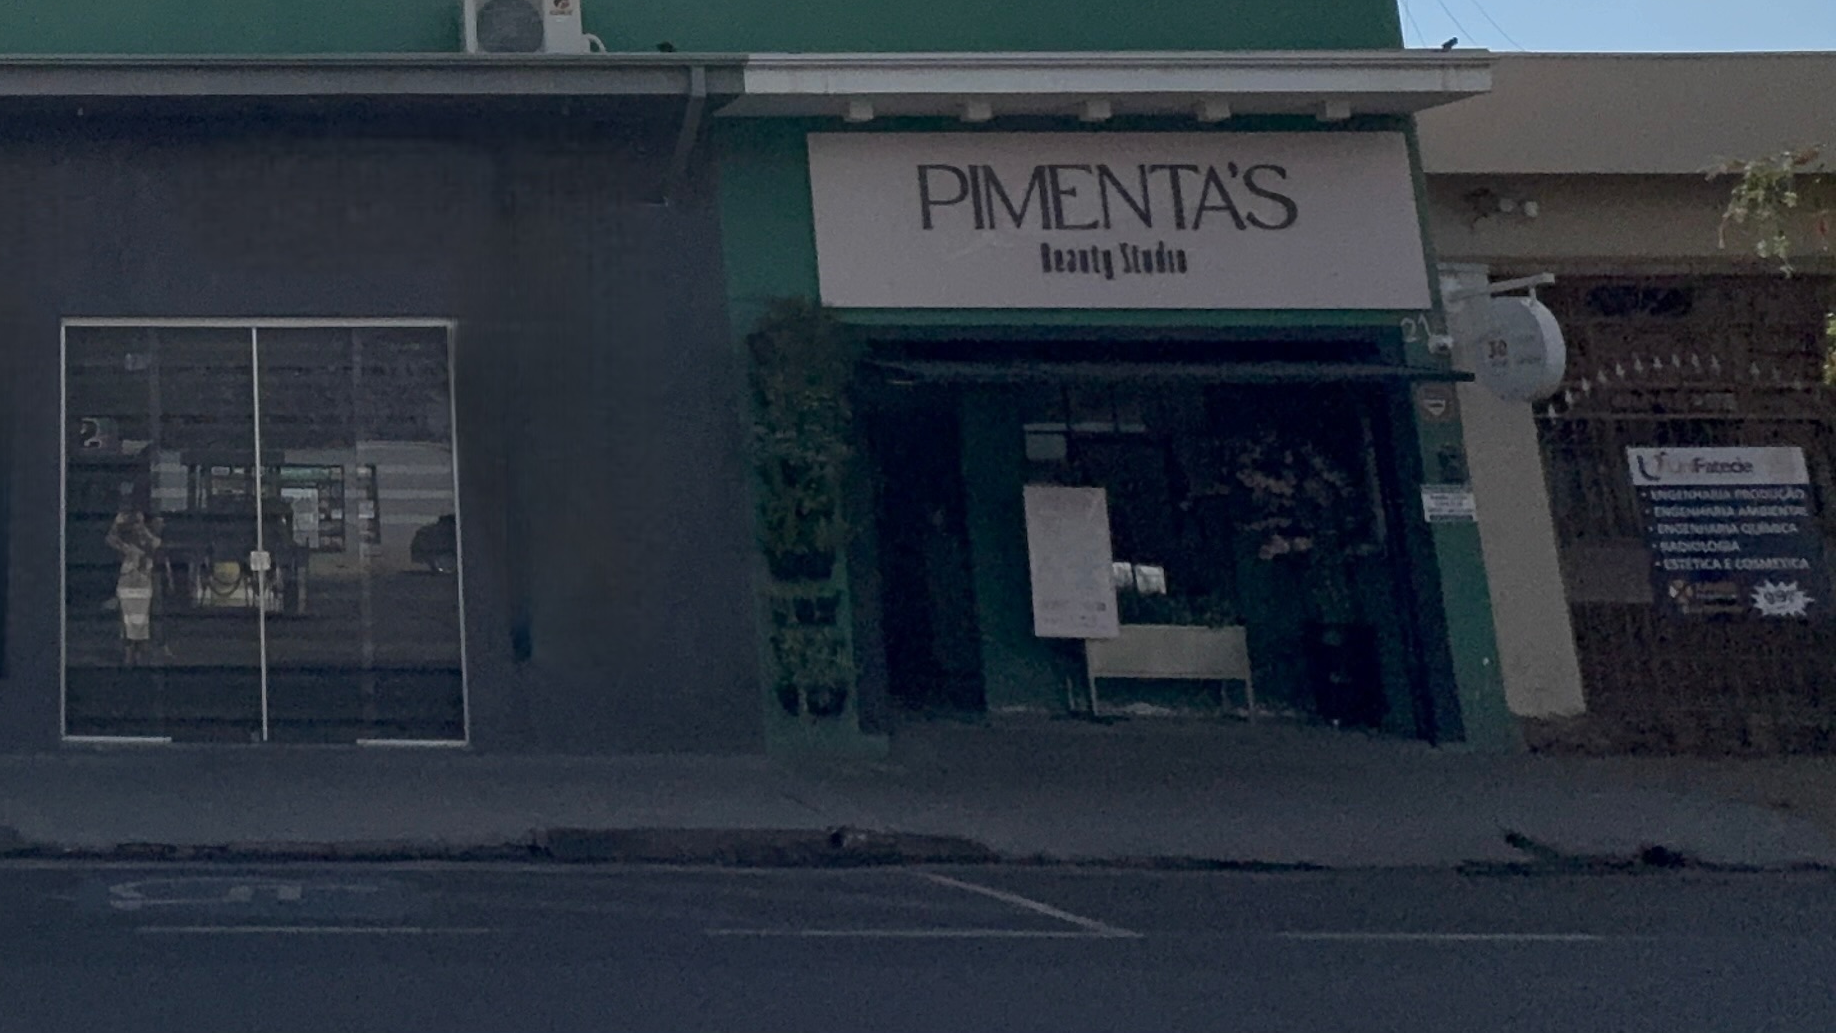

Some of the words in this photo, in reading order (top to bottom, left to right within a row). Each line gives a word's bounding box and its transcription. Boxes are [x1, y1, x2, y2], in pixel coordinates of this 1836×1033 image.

[916, 163, 1299, 232] PIMENTA'S
[1040, 242, 1114, 281] Beauty
[1119, 240, 1187, 274] Studio
[1651, 489, 1731, 501] ENGENHARIA
[1654, 506, 1735, 518] ENGENHARIA
[1658, 523, 1740, 535] ENGENHARIA
[1660, 540, 1740, 553] RADIOLOGIA
[1724, 558, 1731, 570] E
